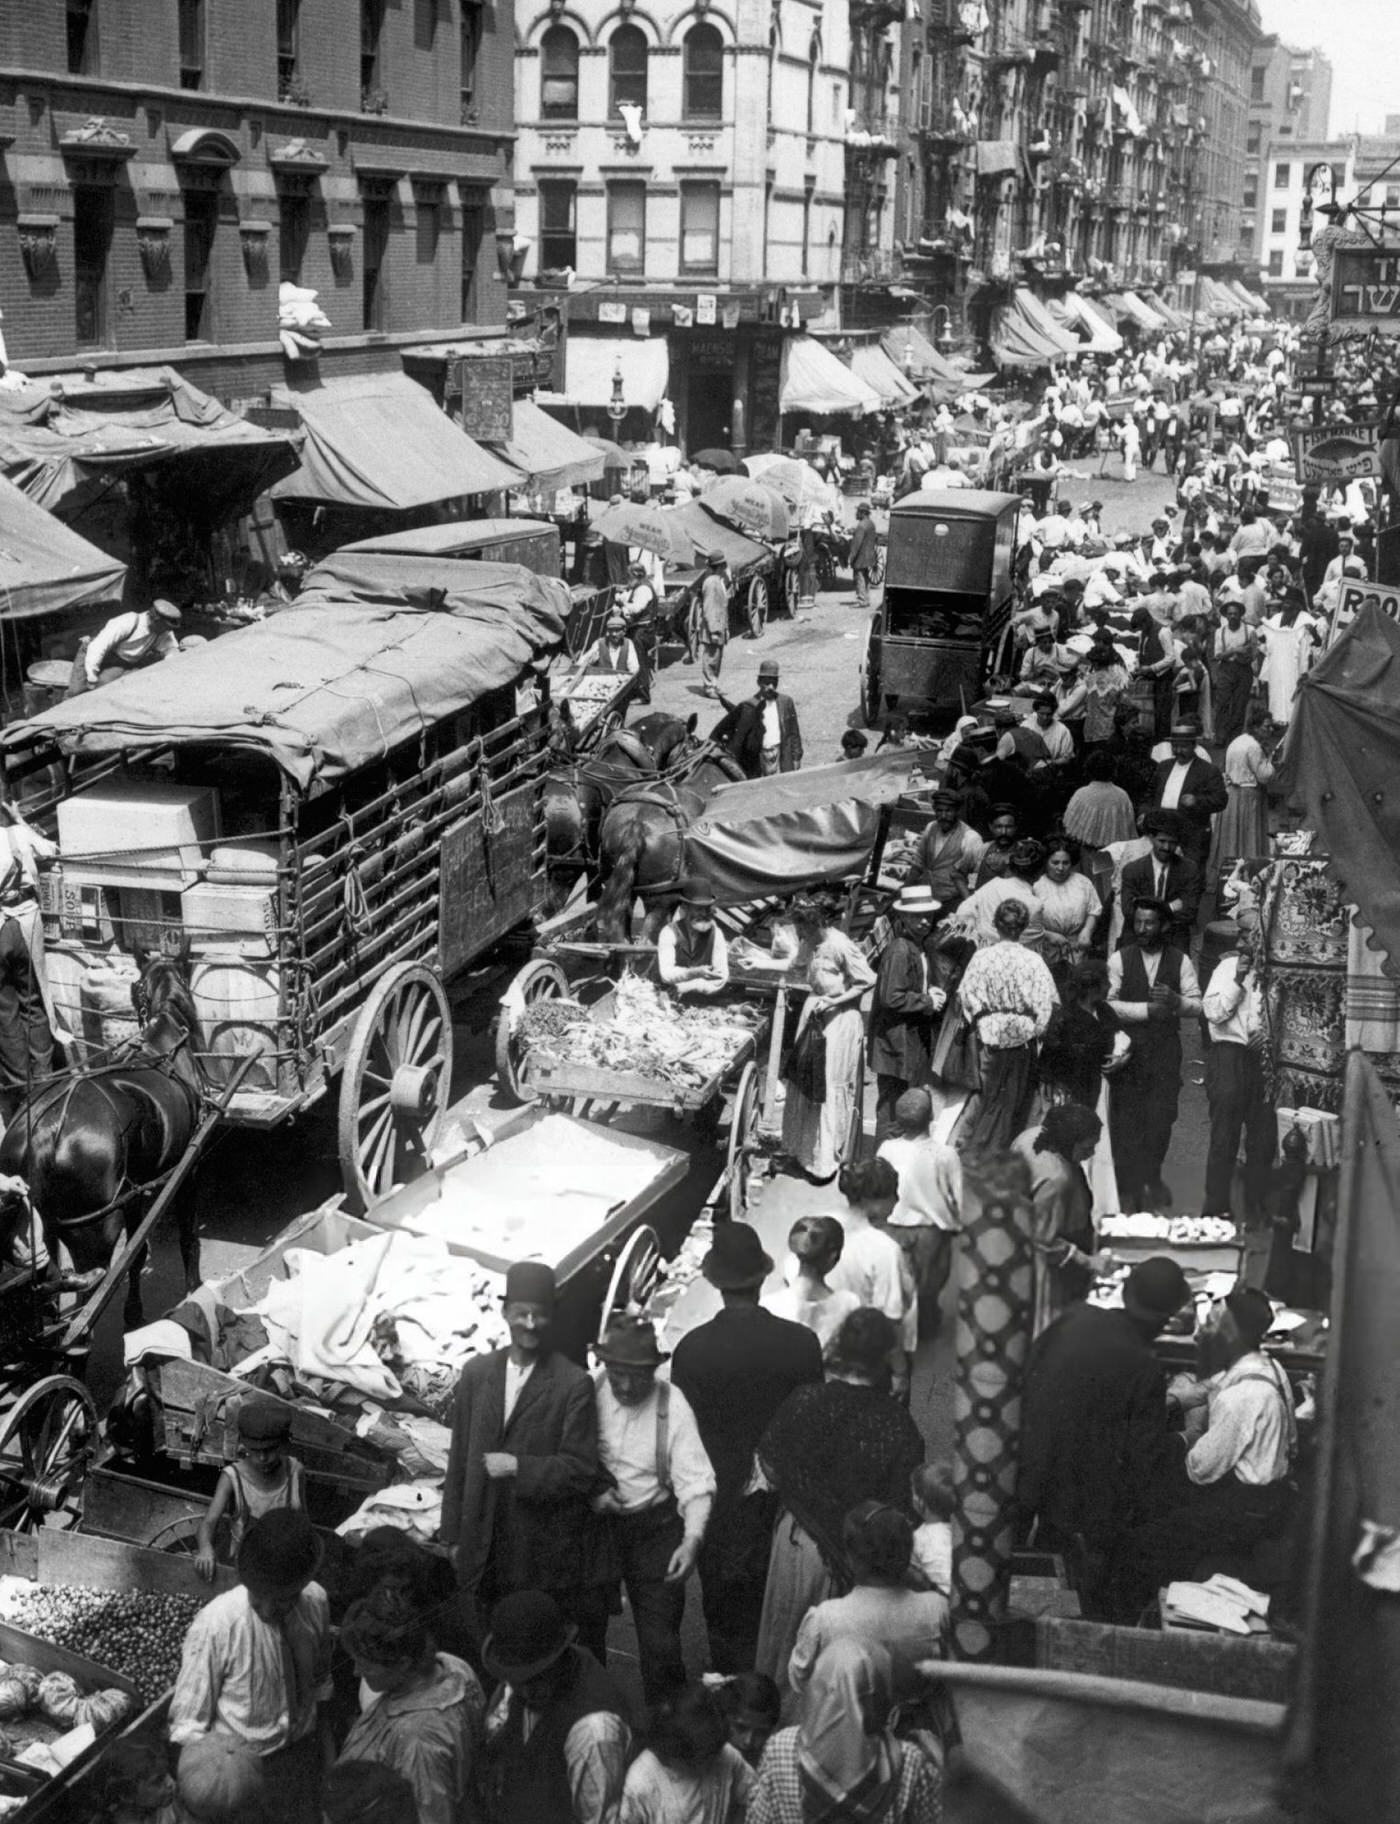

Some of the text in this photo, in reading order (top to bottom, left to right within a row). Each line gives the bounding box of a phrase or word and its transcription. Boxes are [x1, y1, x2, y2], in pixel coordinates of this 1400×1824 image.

[1303, 425, 1374, 453] FISH MARKET
[639, 523, 663, 535] WEAR
